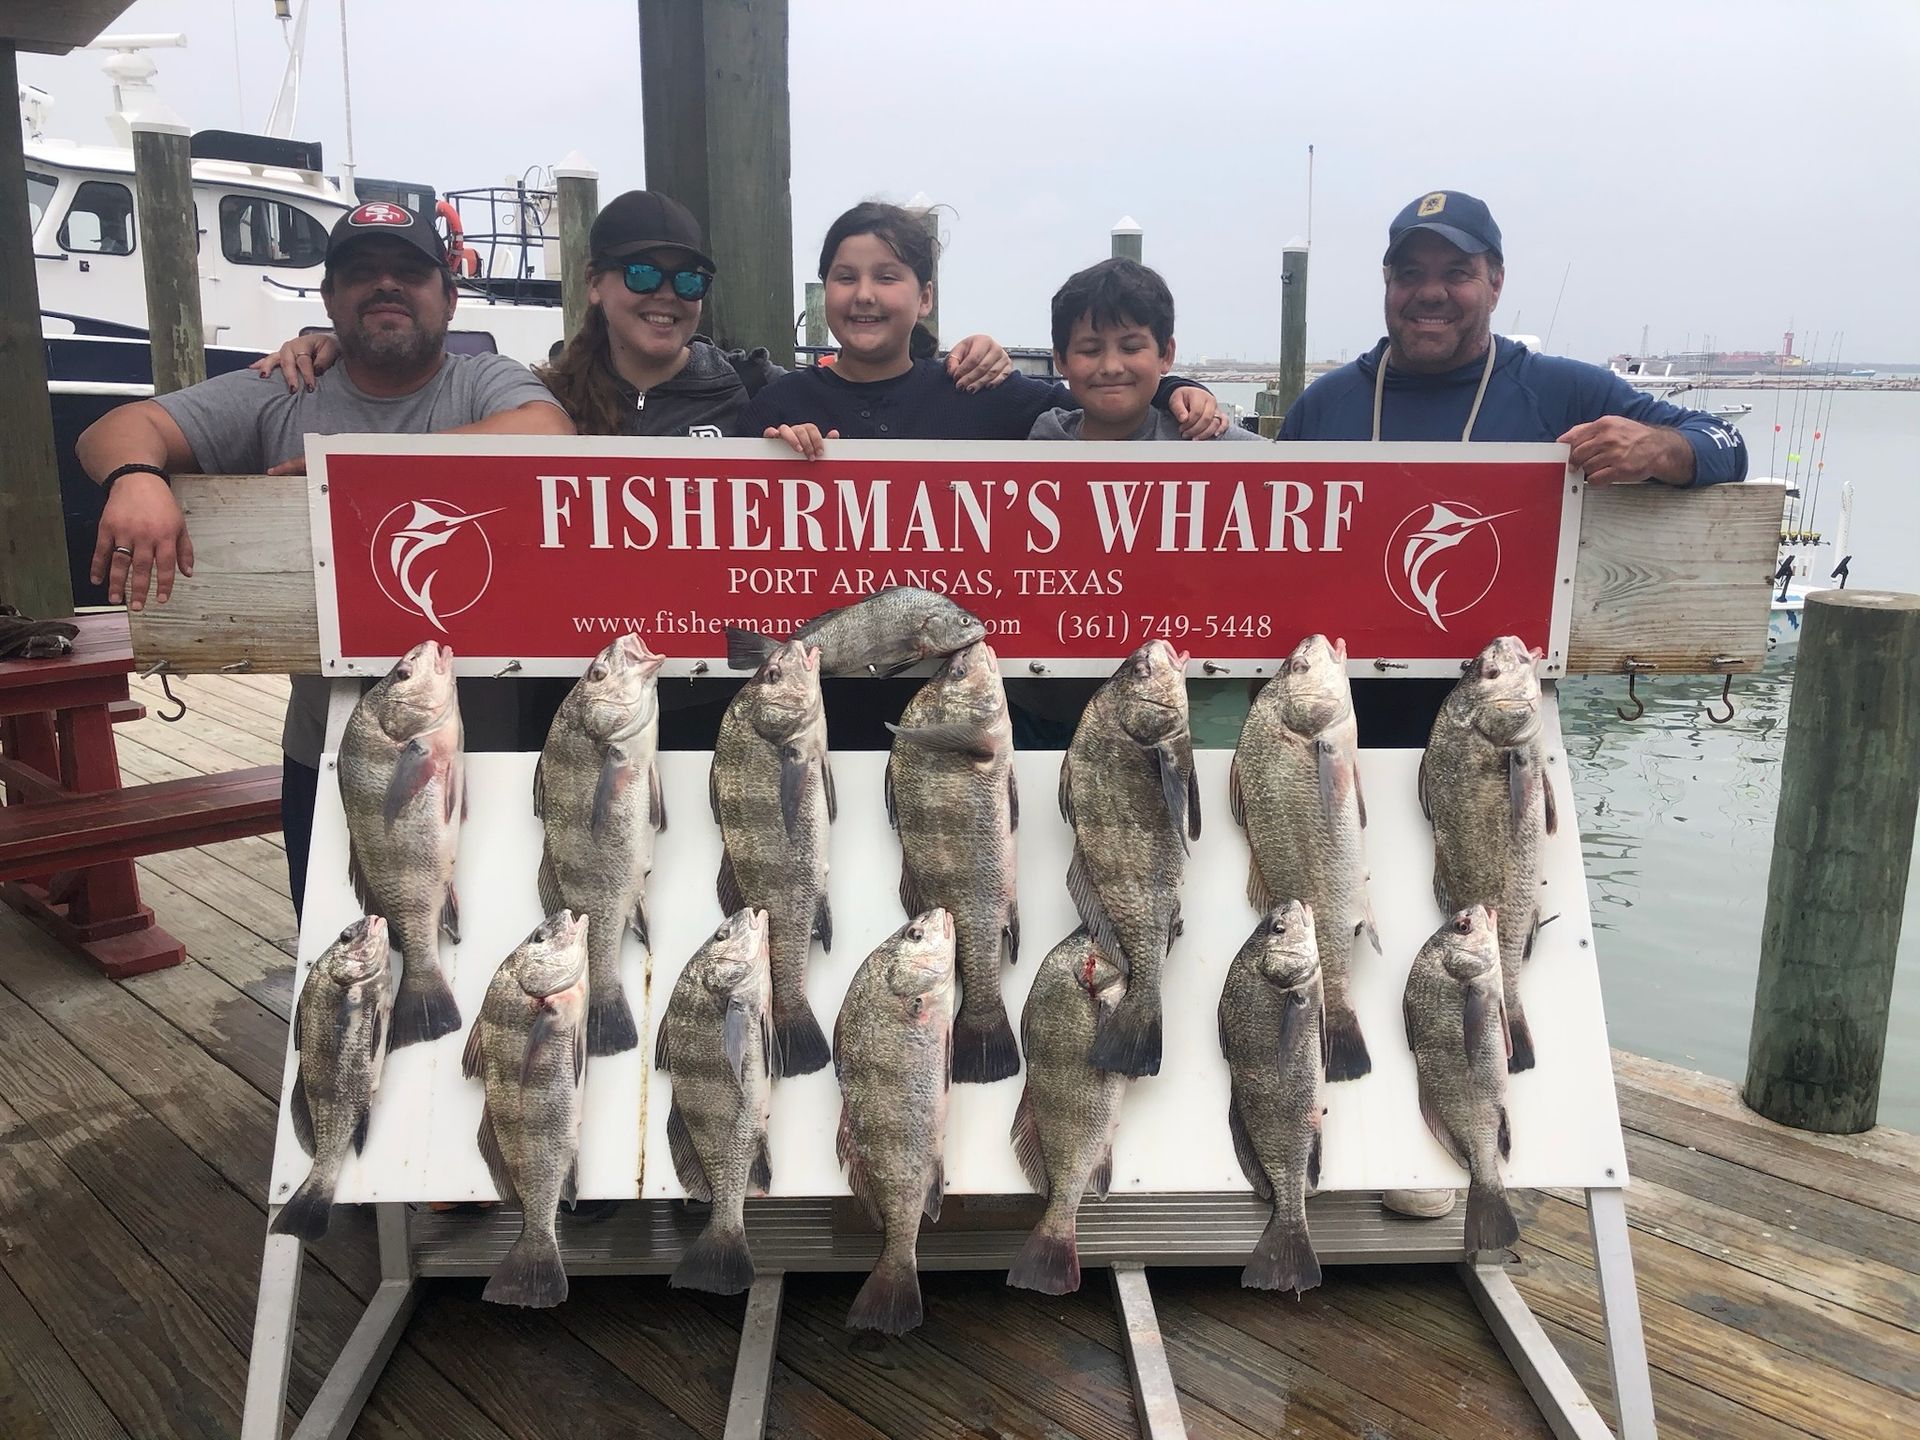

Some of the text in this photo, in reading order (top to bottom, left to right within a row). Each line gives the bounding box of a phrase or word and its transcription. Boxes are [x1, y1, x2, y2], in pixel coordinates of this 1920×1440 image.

[536, 474, 1364, 554] FISHERMAN'S WHARF
[727, 567, 1124, 600] PORT ARANSAS, TEXAS
[1057, 610, 1129, 645] (361)
[1140, 615, 1272, 639] 749-5448
